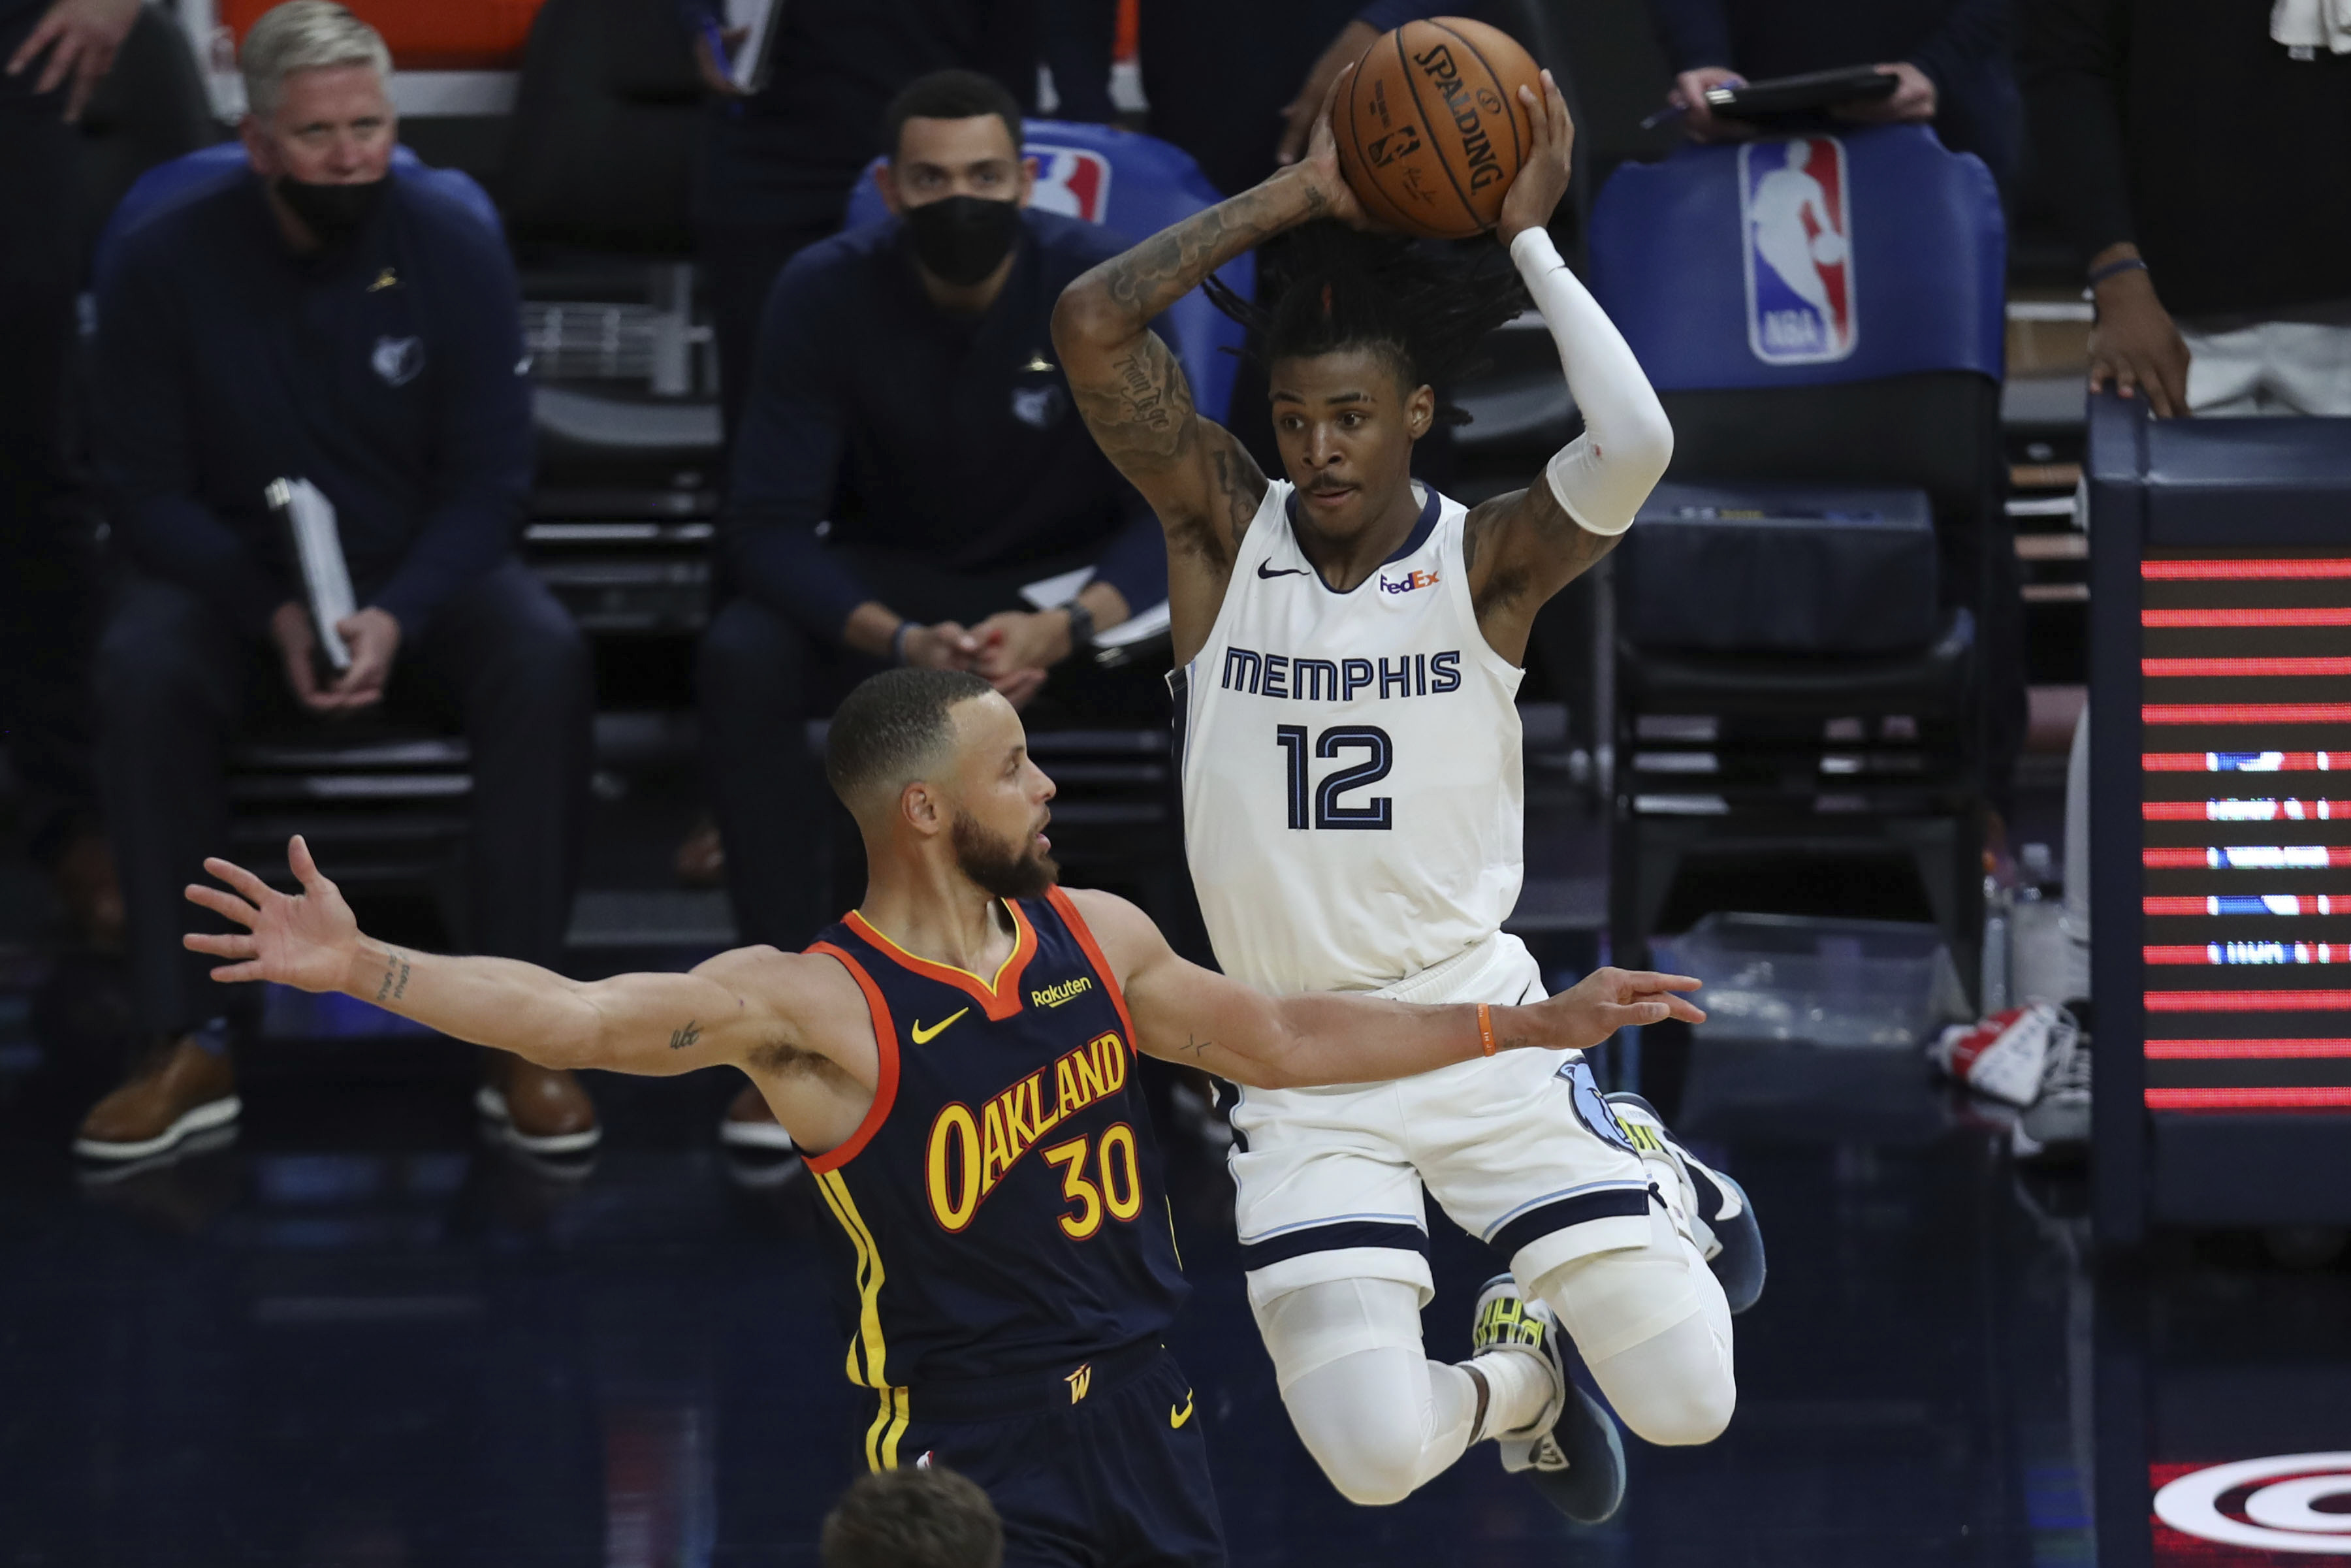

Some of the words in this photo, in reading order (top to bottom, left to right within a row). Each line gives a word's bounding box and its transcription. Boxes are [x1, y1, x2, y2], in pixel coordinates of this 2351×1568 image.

[1414, 44, 1503, 195] SPALDING
[1765, 309, 1817, 346] NBA
[1380, 570, 1439, 594] FedEx
[1221, 646, 1461, 701] MEMPHIS
[1277, 724, 1393, 830] 12
[1031, 977, 1092, 1007] Rakuten
[925, 1029, 1127, 1234] OAKLAND
[1039, 1121, 1143, 1240] 30
